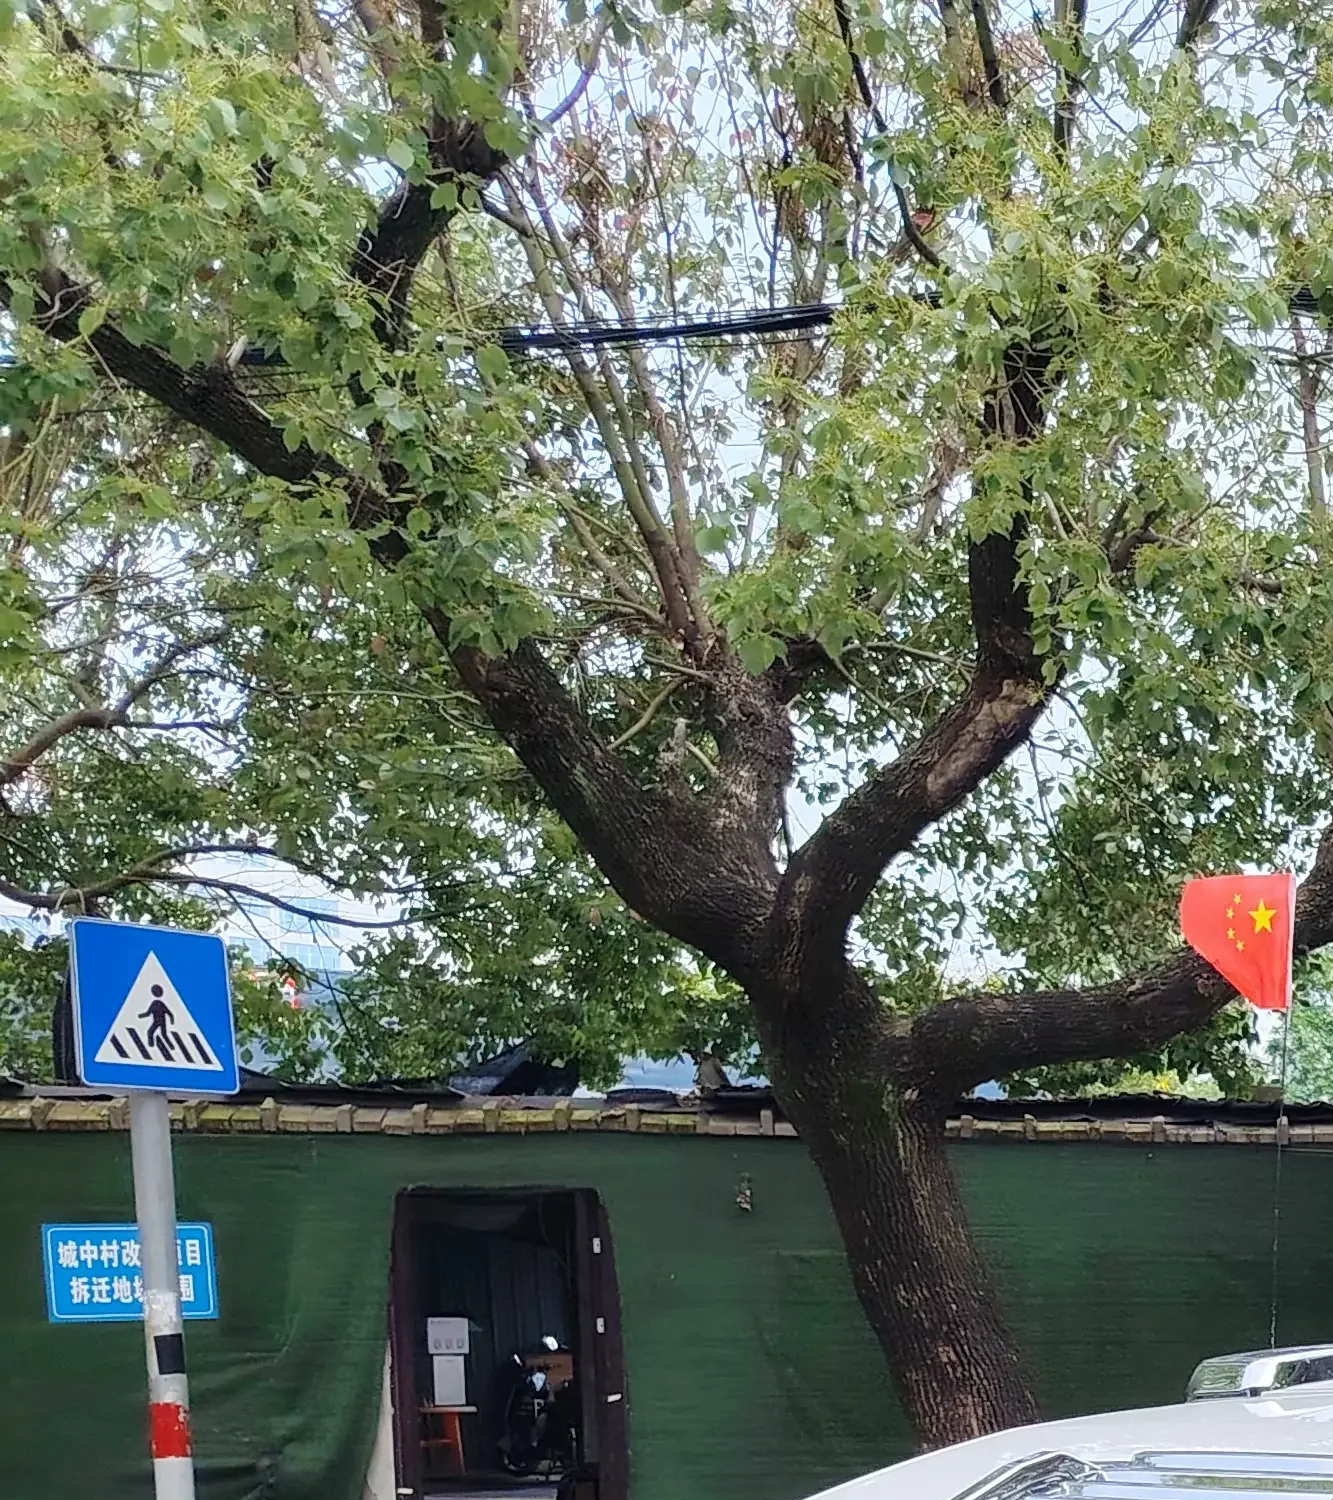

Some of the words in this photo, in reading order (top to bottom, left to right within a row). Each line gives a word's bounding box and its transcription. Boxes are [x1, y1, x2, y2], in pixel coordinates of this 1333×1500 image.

[57, 1239, 202, 1269] 城中村改目
